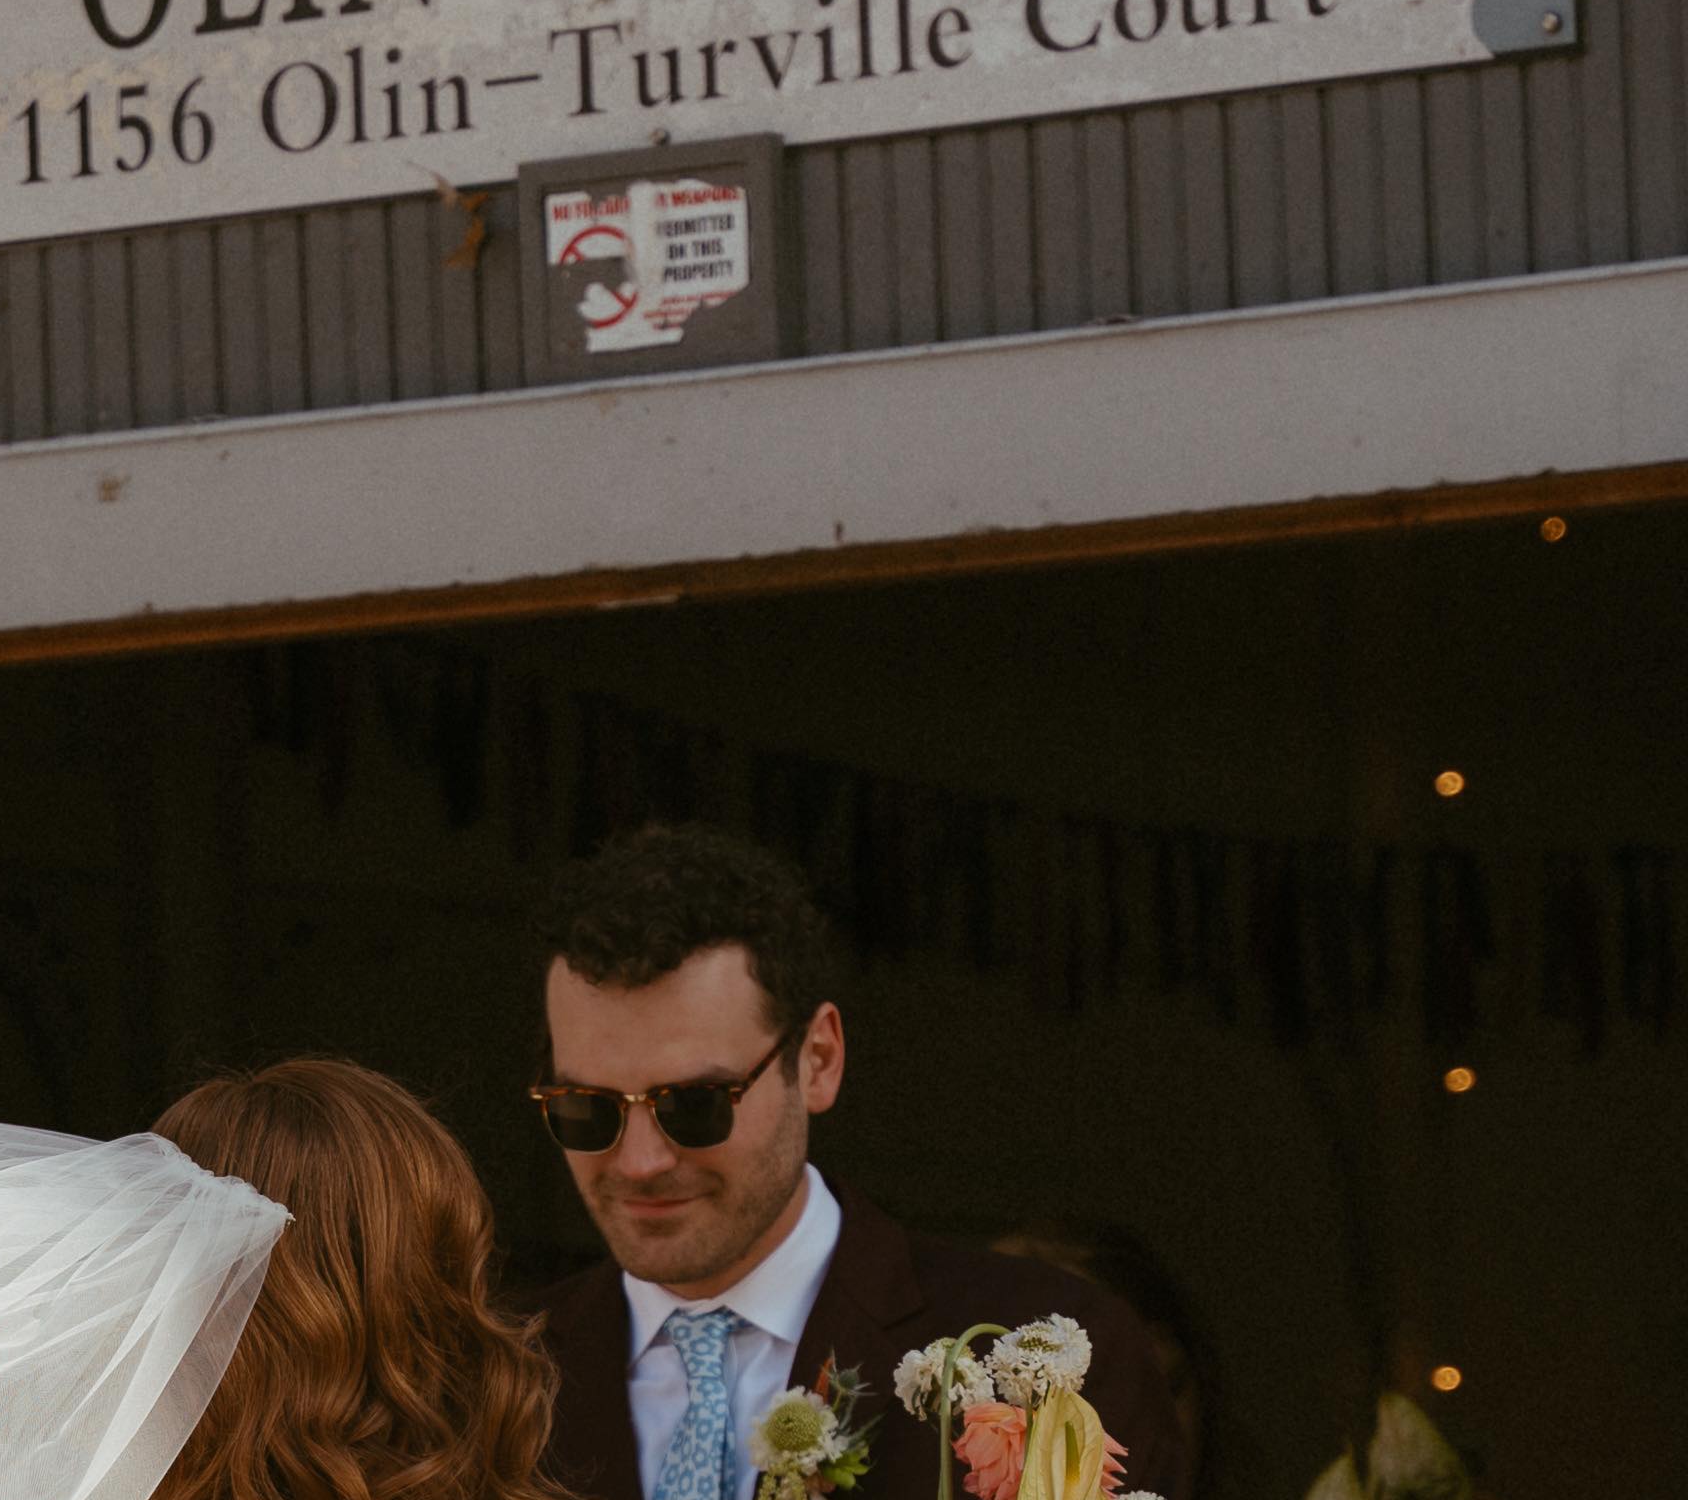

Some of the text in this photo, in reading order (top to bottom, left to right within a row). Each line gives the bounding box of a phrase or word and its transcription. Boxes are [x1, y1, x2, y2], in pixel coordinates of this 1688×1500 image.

[18, 76, 214, 185] 1156
[692, 239, 724, 257] THIS
[664, 260, 733, 282] PROPERTY
